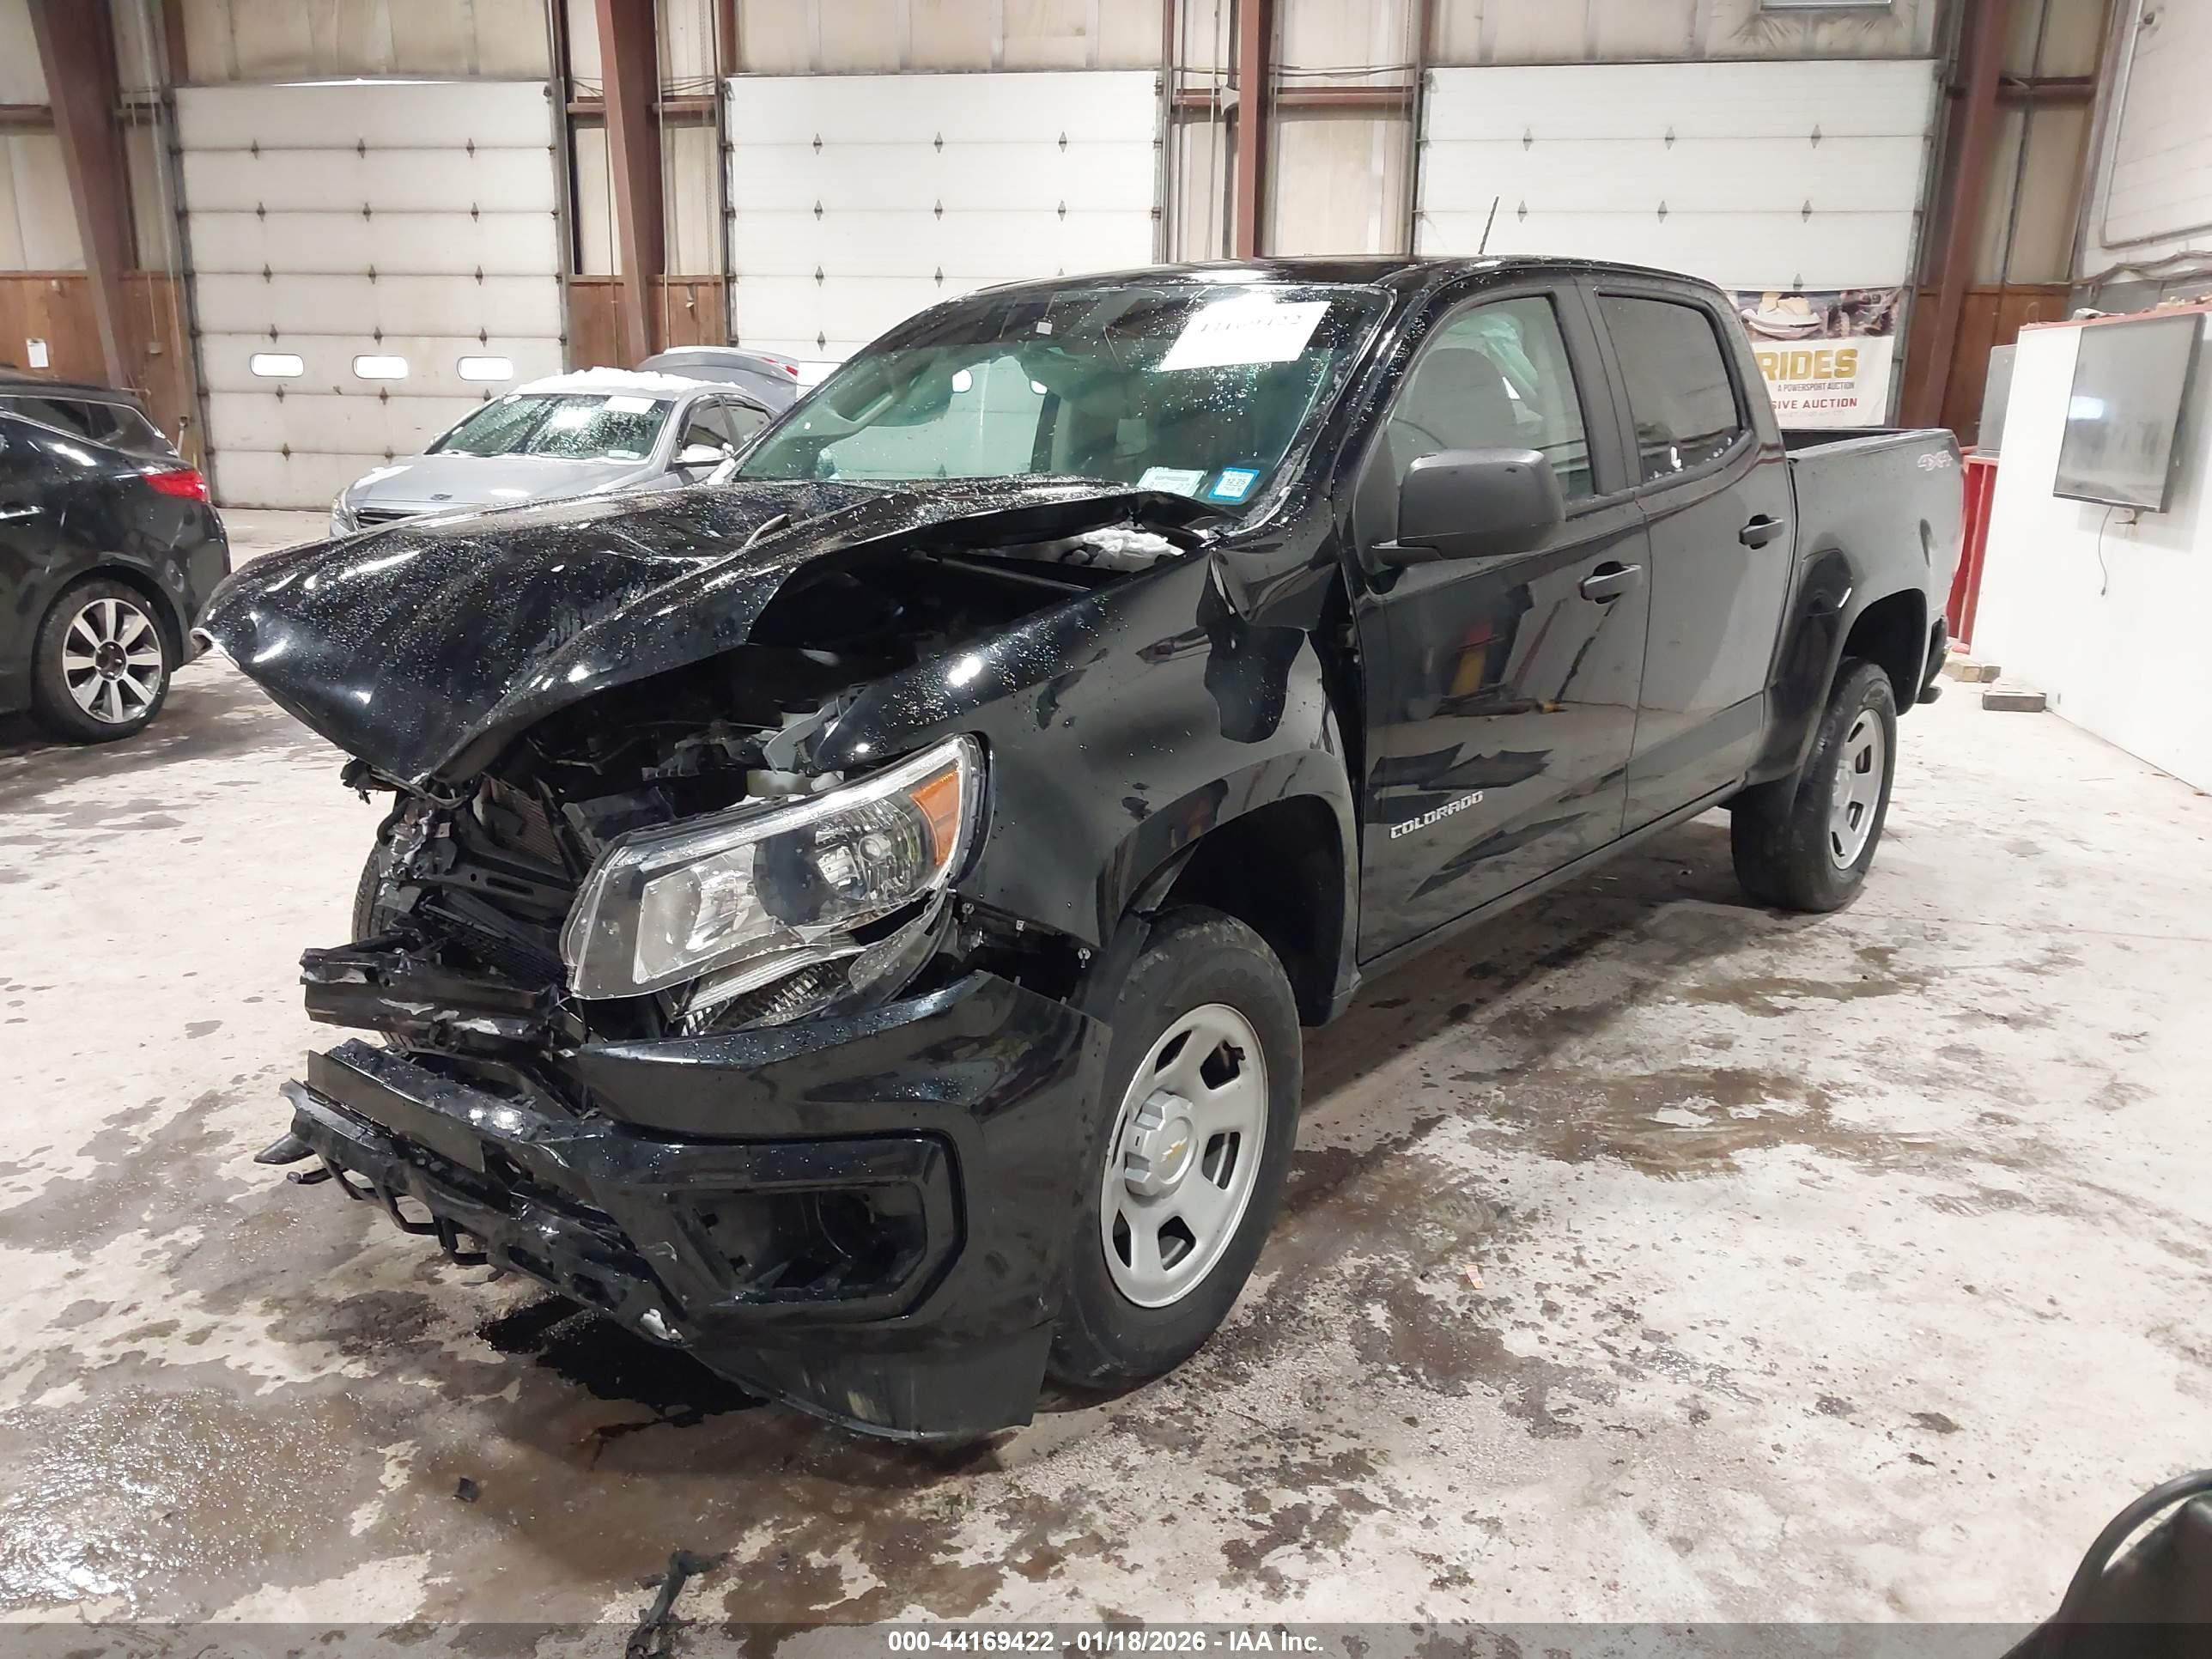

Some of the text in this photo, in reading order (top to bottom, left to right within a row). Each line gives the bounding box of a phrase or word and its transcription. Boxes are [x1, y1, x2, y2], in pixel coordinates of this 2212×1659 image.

[1755, 348, 1858, 380] RIDES
[1778, 381, 1855, 392] A POWERSPORT AUCTION
[1802, 398, 1857, 409] AUCTION
[1390, 790, 1484, 839] COLORADO
